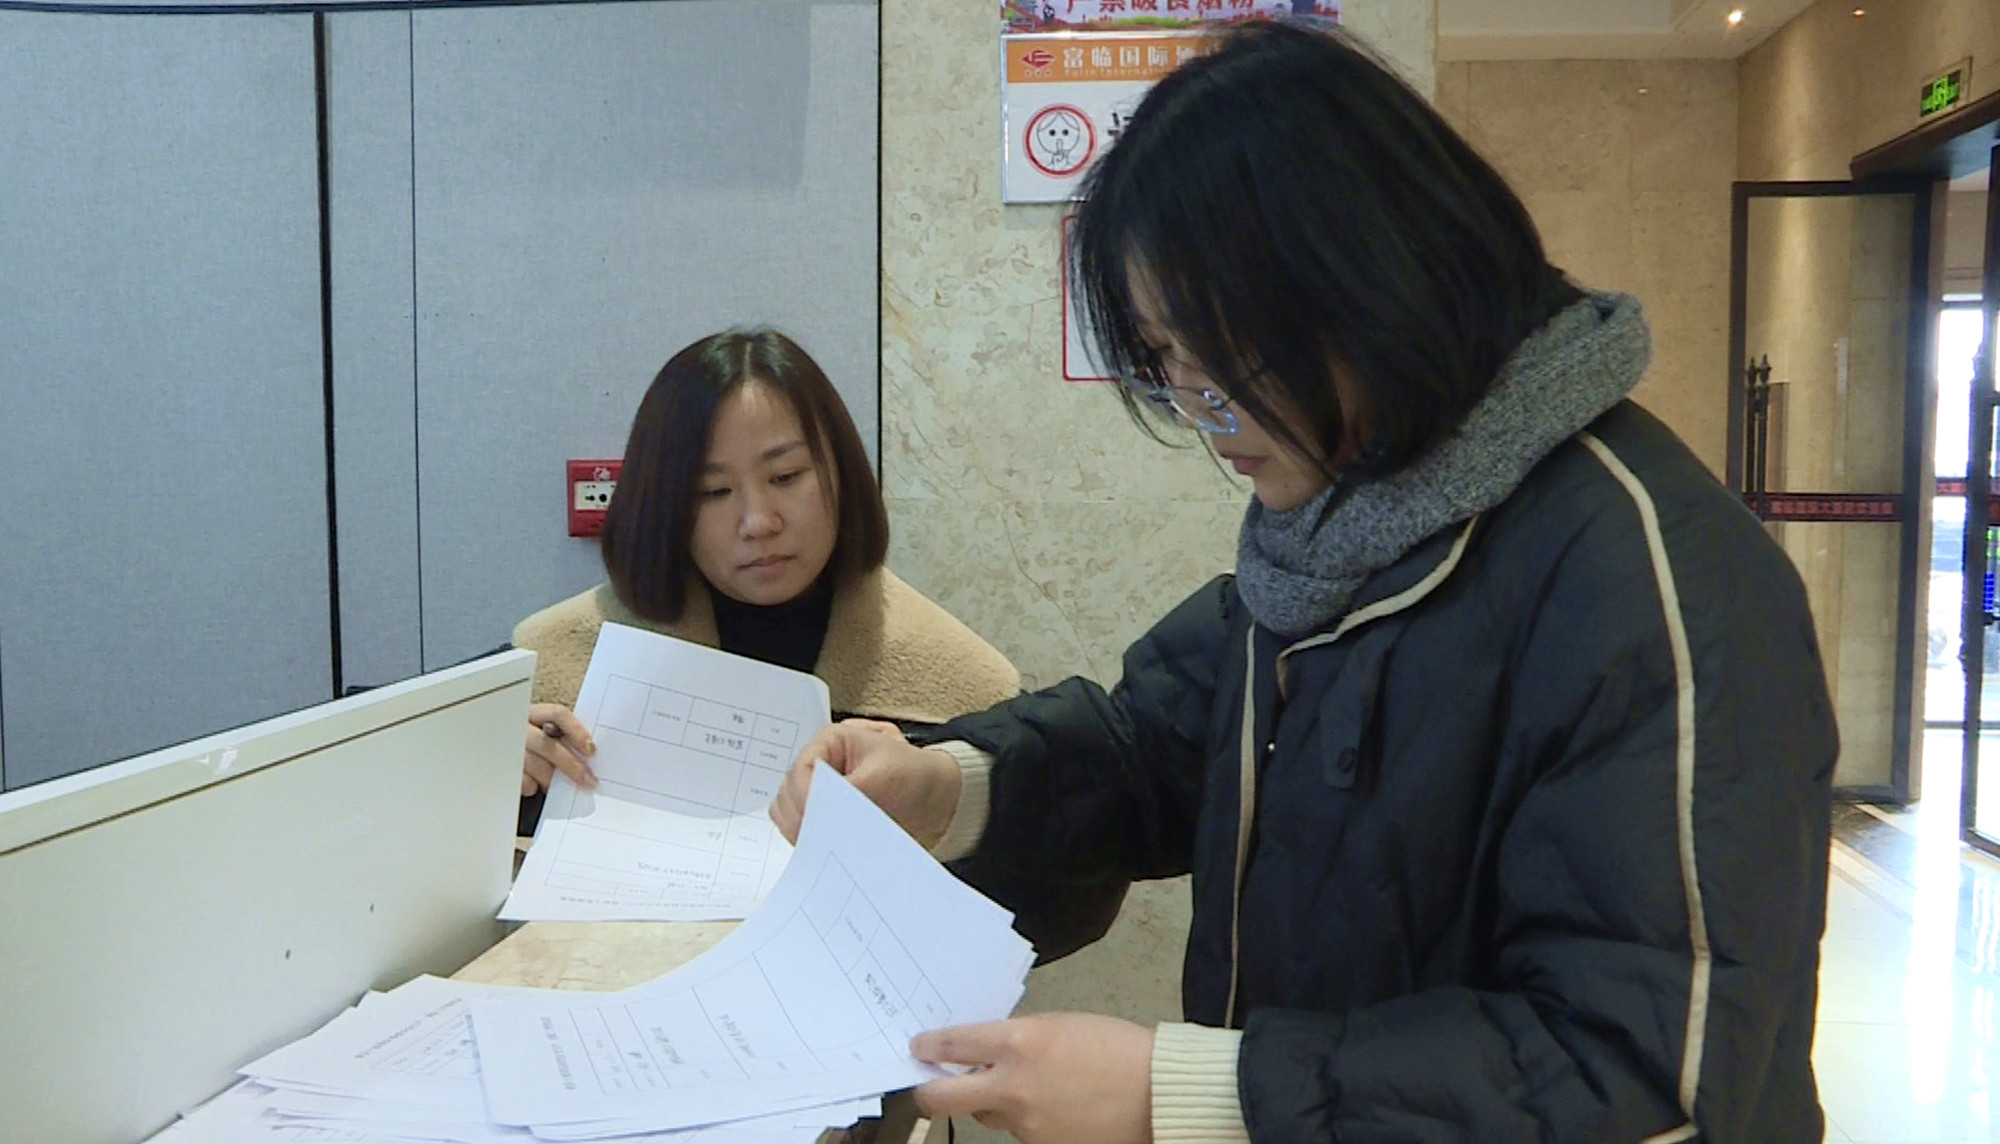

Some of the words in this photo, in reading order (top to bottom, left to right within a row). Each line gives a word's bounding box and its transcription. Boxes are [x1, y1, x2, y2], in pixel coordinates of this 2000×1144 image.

[1063, 46, 1213, 68] 富临国际酒
